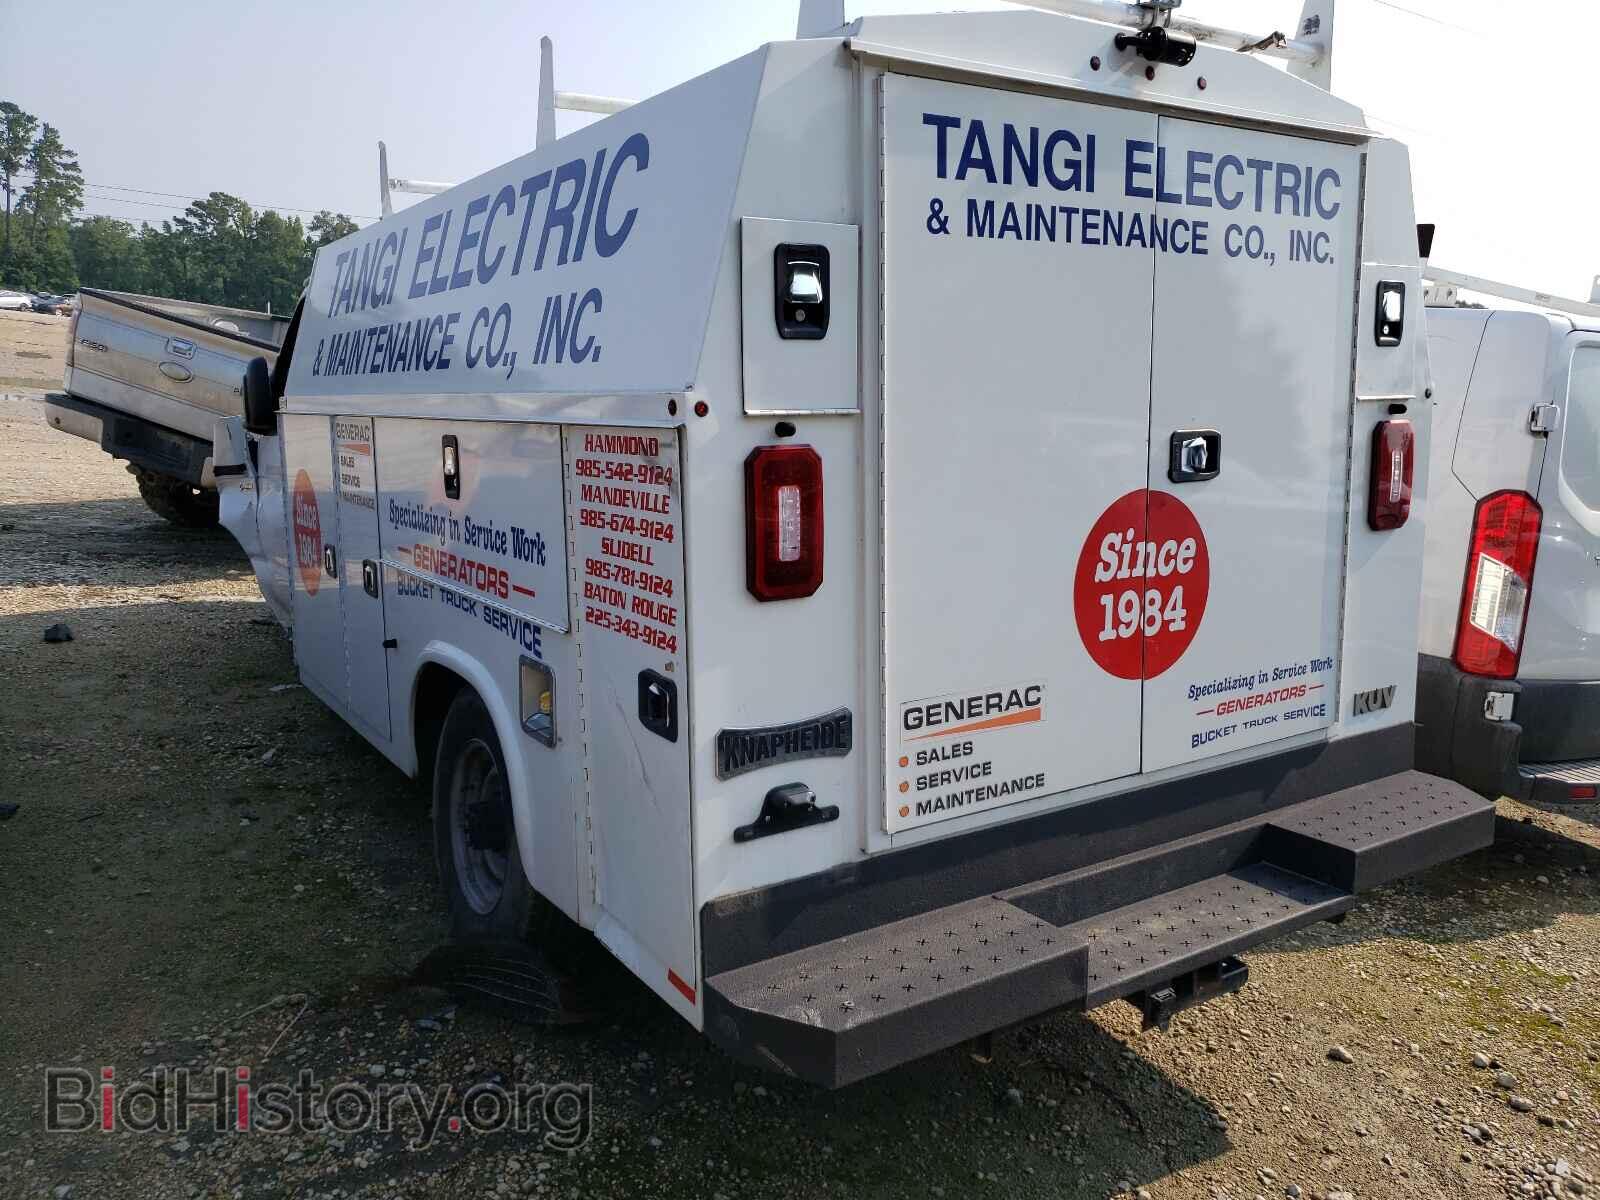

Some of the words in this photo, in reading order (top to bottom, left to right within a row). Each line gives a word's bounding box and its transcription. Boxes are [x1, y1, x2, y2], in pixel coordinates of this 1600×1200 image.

[922, 112, 1096, 193] TANGI
[1124, 139, 1342, 220] ELECTRIC
[328, 227, 408, 318] TANGI
[408, 133, 650, 299] ELECTRIC
[926, 197, 951, 235] &
[966, 198, 1209, 255] MAINTENANCE
[1224, 223, 1277, 266] CO.,
[1288, 229, 1335, 264] INC.
[312, 338, 325, 376] &
[323, 312, 461, 376] MAINTENANCE
[465, 302, 518, 379] CO.,
[532, 287, 603, 364] INC.
[336, 422, 370, 441] GENERAC
[584, 433, 659, 456] HAMMOND
[341, 456, 355, 468] SALES
[342, 473, 360, 488] SERVICE
[575, 458, 673, 486] 985-542-9124
[296, 495, 318, 530] Since
[342, 490, 375, 510] MAINTENANCE
[581, 483, 670, 514] MANDEVILLE
[389, 498, 446, 546] Specializing
[449, 511, 461, 542] in
[464, 515, 508, 555] Service
[511, 526, 546, 567] Work
[580, 508, 674, 543] 985-674-9124
[298, 533, 318, 568] 1984
[413, 543, 509, 599] GENERATORS
[601, 537, 654, 566] SLIDELL
[1094, 527, 1197, 582] Since
[585, 558, 673, 598] 985-781-9124
[397, 572, 435, 599] BUCKET
[440, 587, 477, 617] TRUCK
[483, 605, 543, 659] SERVICE
[584, 581, 627, 609] BATON
[632, 595, 678, 627] ROUGE
[1098, 585, 1187, 641] 1984
[585, 605, 677, 654] 225-343-9124
[1188, 674, 1256, 701] Specializing
[1258, 669, 1269, 684] in
[1272, 663, 1307, 682] Service
[1310, 656, 1333, 673] Work
[903, 684, 1042, 731] GENERAC
[1216, 684, 1307, 716] GENERATORS
[1352, 685, 1397, 717] KUV
[717, 714, 850, 773] KNAPHEIDE
[1191, 724, 1238, 749] BUCKET
[1242, 715, 1278, 729] TRUCK
[1283, 703, 1327, 720] SERVICE
[916, 740, 974, 766] SALES
[915, 773, 1045, 817] MAINTENANCE
[916, 761, 992, 791] SERVICE
